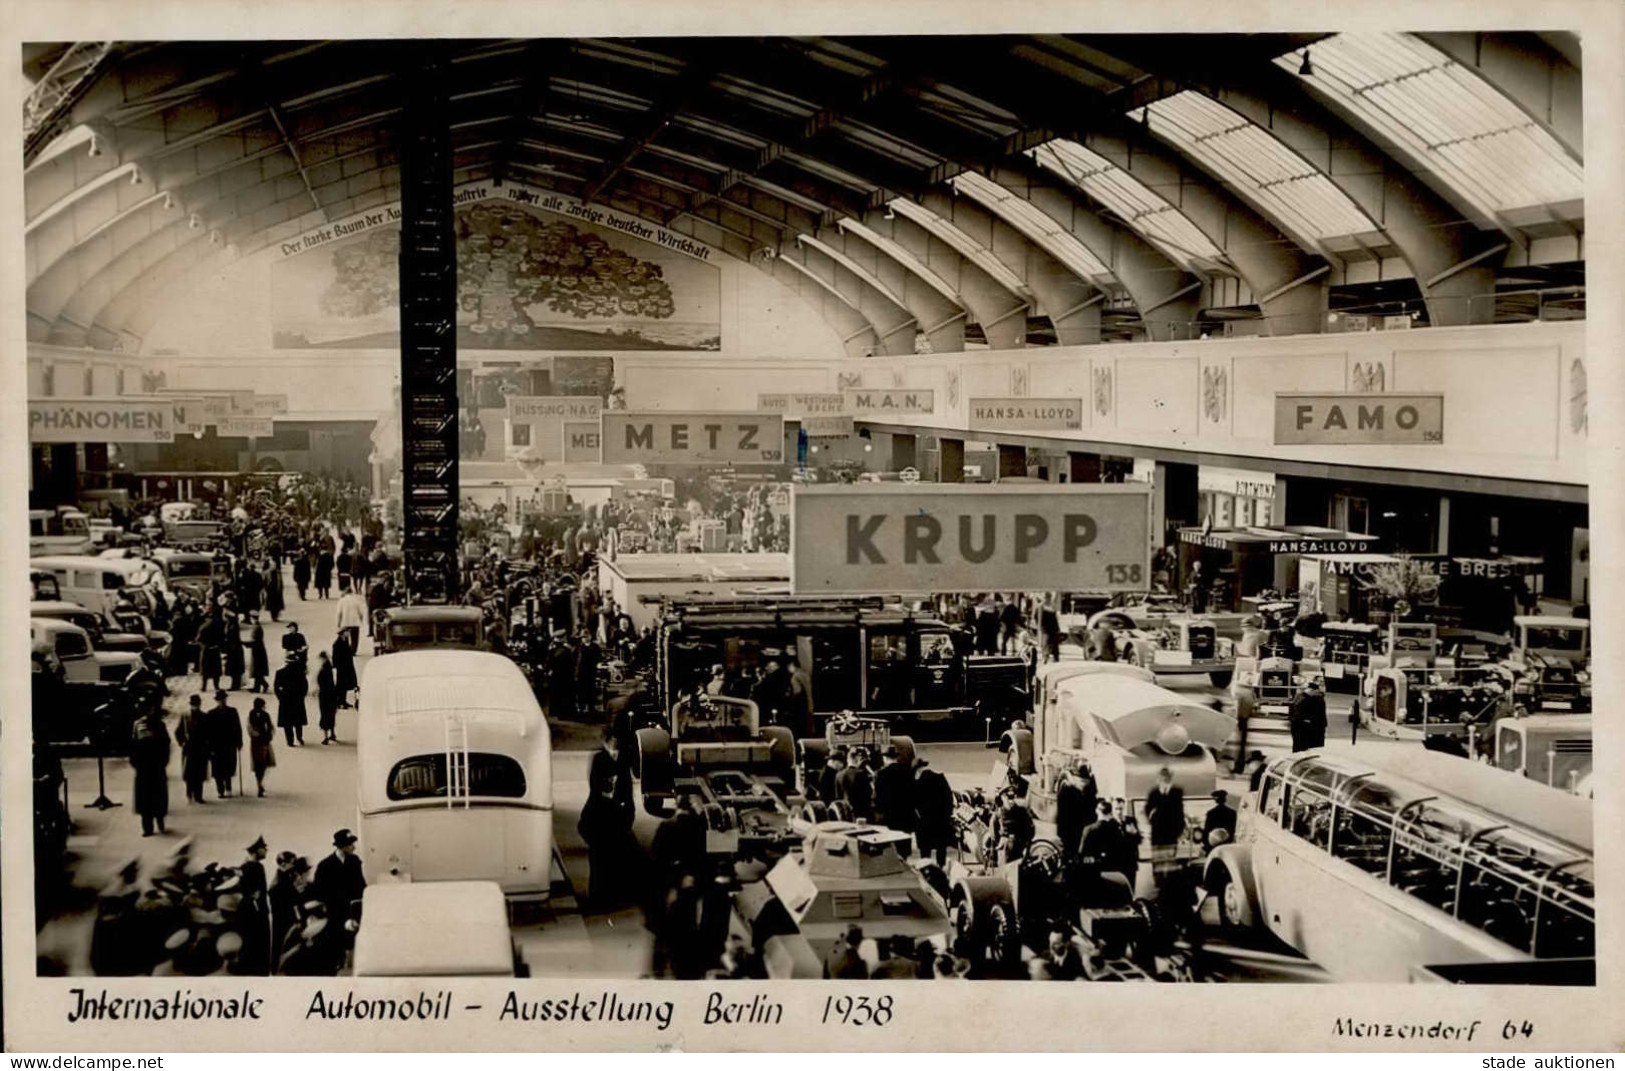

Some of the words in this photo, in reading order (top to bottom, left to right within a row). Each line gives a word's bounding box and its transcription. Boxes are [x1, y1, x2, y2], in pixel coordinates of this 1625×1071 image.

[334, 219, 365, 238] Baum
[366, 211, 384, 228] der
[566, 200, 604, 223] Zweige
[30, 407, 163, 428] PHÄNOMEN
[1296, 405, 1420, 430] FAMO
[625, 424, 759, 449] METZ
[846, 514, 1098, 565] KRUPP
[1270, 541, 1368, 553] HANSA-LLOYD
[1105, 564, 1141, 584] 138
